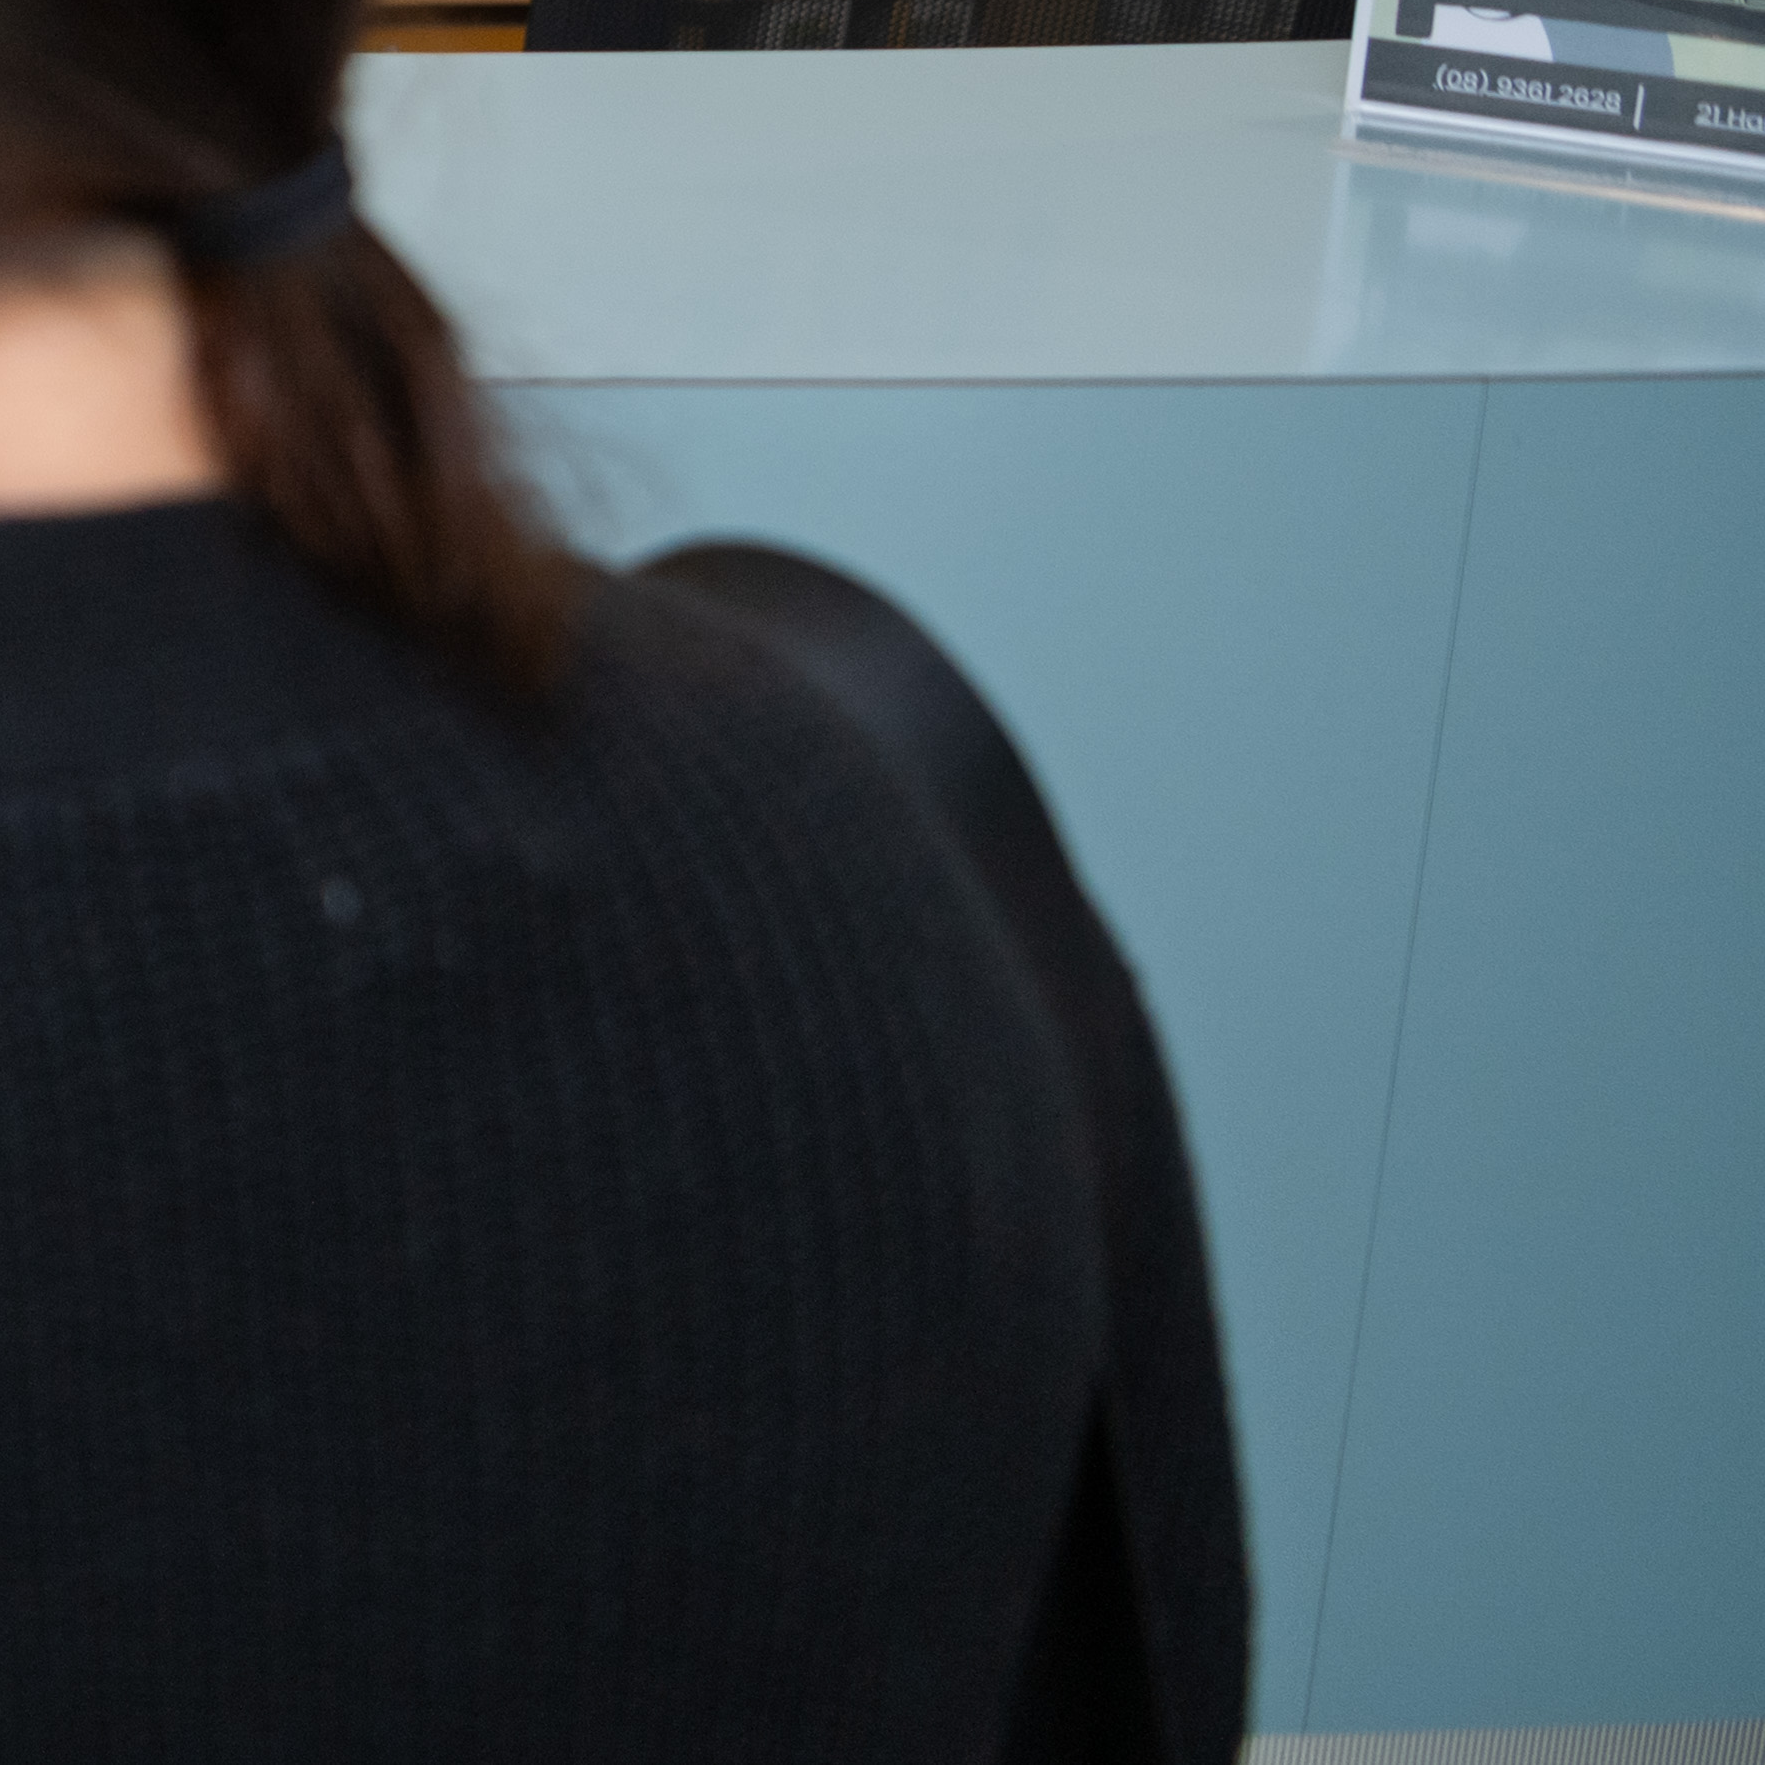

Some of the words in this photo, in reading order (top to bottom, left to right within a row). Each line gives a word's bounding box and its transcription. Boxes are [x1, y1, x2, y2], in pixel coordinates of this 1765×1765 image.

[1435, 63, 1490, 94] (08)
[1496, 76, 1552, 103] 9361
[1558, 84, 1621, 111] 2628
